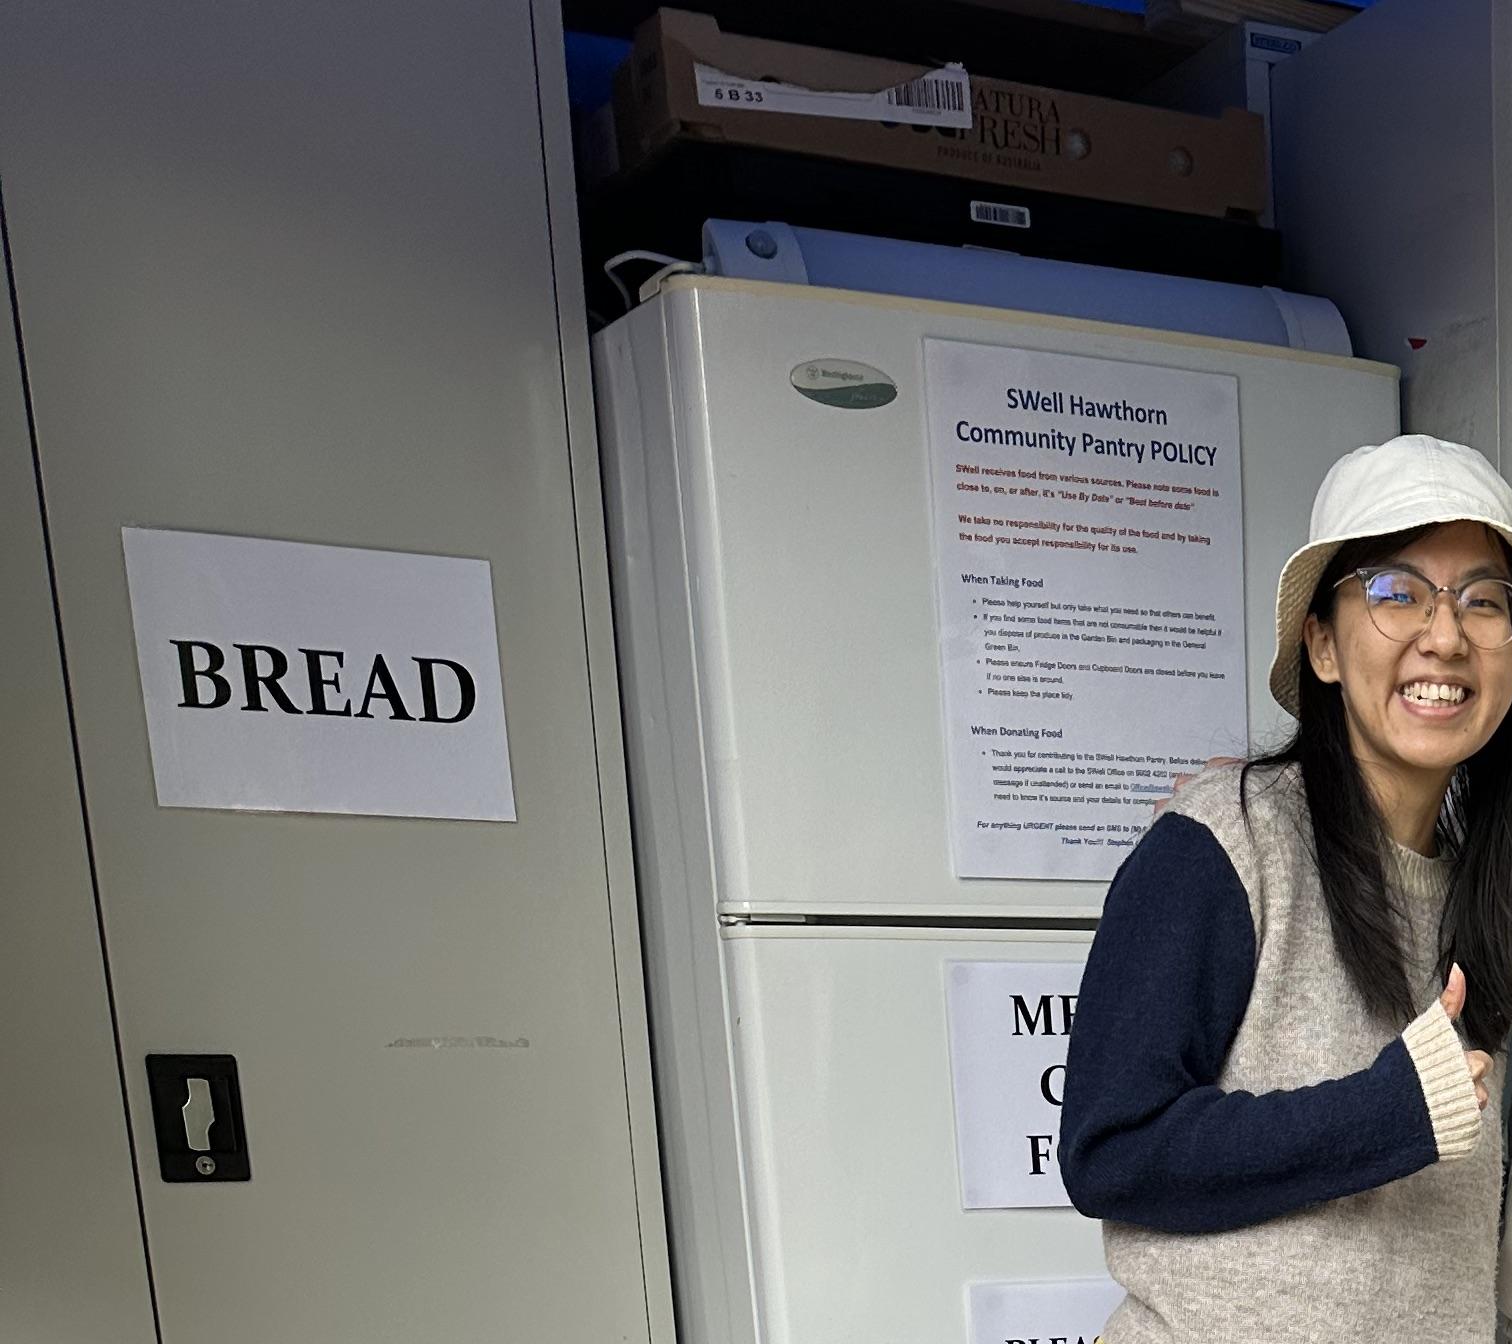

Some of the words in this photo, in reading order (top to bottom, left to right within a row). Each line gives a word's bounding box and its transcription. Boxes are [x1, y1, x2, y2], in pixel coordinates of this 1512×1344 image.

[728, 89, 740, 101] B
[745, 90, 763, 103] 33
[974, 88, 1061, 124] ATURA
[1006, 387, 1064, 414] SWell
[1069, 395, 1168, 426] Hawthorn
[956, 420, 1076, 457] Community
[1082, 433, 1145, 463] Pantry
[1151, 440, 1217, 466] POLICY
[958, 514, 971, 524] We
[973, 516, 991, 525] take
[1005, 519, 1061, 532] responsibility
[1062, 523, 1074, 531] for
[1075, 524, 1089, 533] the
[1091, 526, 1116, 537] quality
[1128, 528, 1140, 537] the
[1142, 529, 1159, 539] food
[1161, 532, 1175, 541] and
[1177, 532, 1186, 544] by
[1188, 534, 1211, 546] taking
[961, 573, 989, 585] When
[990, 575, 1020, 588] Taking
[1021, 578, 1044, 588] Food
[169, 638, 478, 725] BREAD
[971, 725, 998, 737] When
[999, 726, 1040, 740] Donating
[1041, 728, 1063, 739] Food
